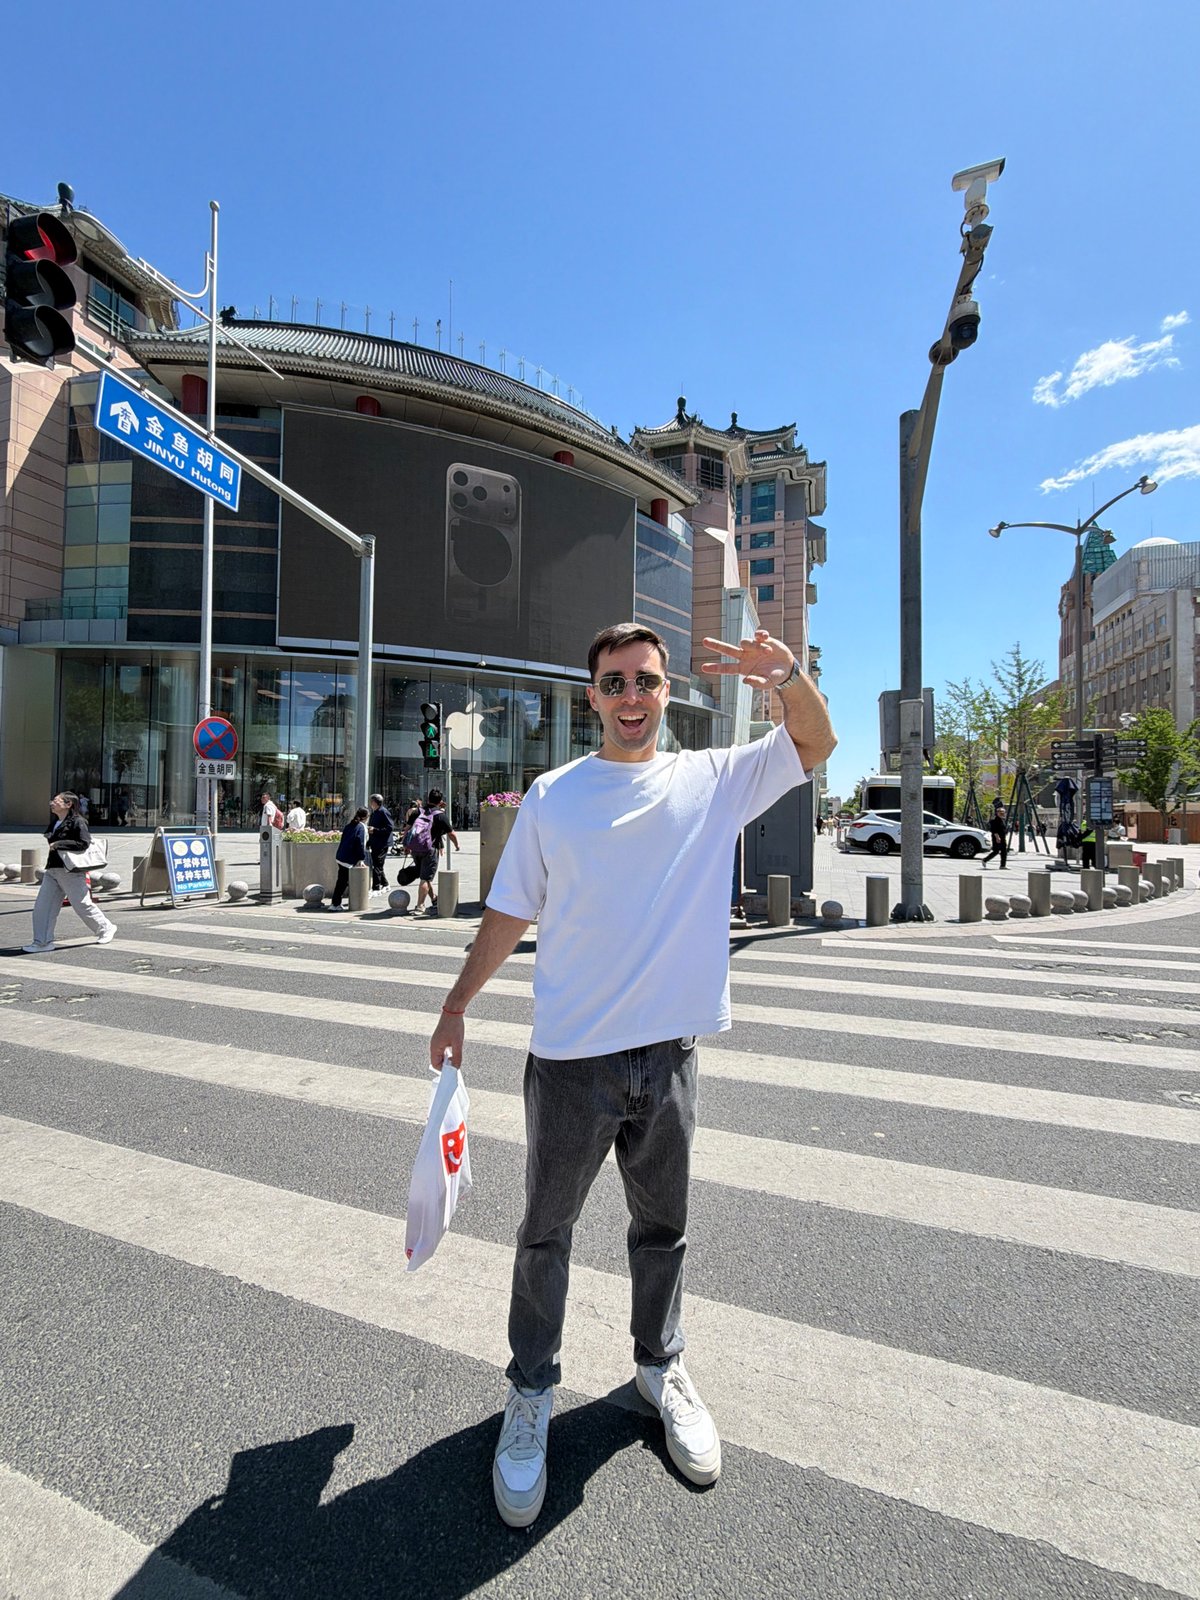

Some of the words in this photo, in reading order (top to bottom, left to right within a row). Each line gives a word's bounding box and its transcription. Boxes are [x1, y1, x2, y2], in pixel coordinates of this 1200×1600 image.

[120, 407, 131, 421] 东
[145, 415, 234, 485] 金鱼胡同
[144, 440, 185, 469] JINYU
[191, 467, 231, 501] Hutong
[198, 763, 234, 775] 金鱼胡同
[174, 857, 209, 869] 严禁停放
[176, 869, 211, 882] 各种车辆
[188, 880, 213, 889] Parking
